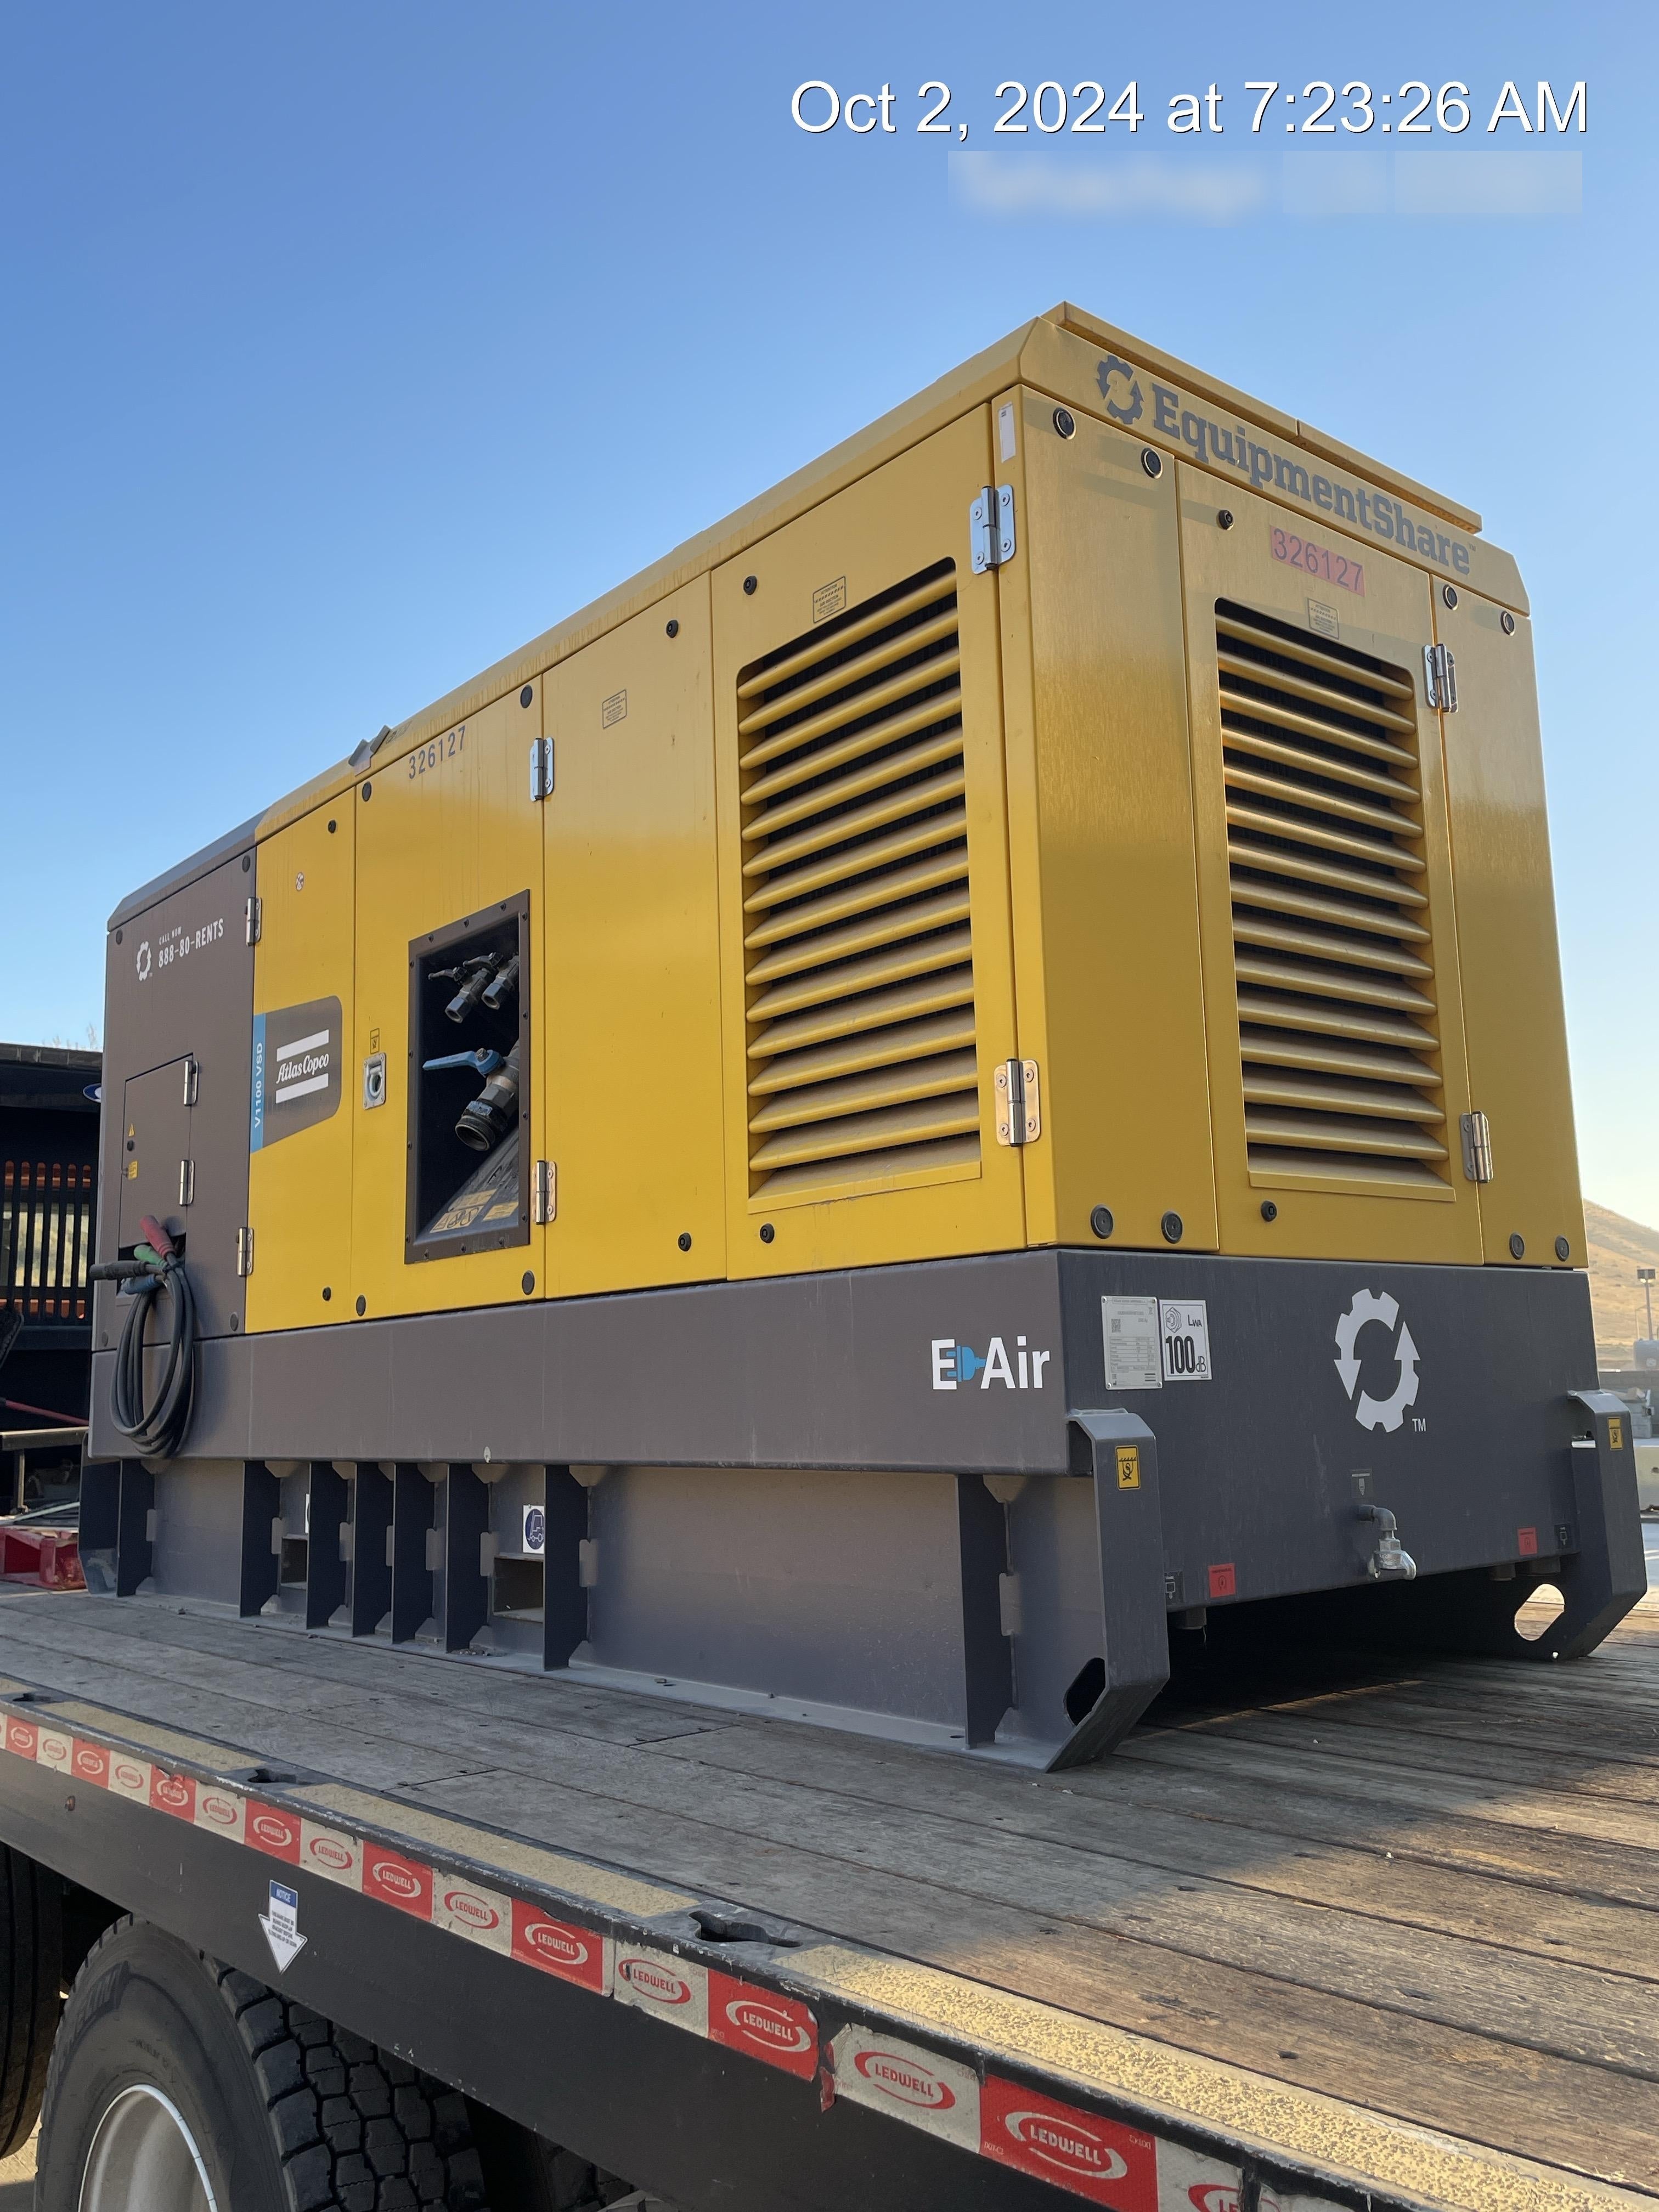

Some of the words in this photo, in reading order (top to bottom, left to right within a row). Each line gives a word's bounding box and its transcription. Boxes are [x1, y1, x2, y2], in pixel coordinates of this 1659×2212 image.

[1151, 381, 1471, 576] EquipmentShare
[1273, 527, 1364, 592] 326127
[408, 724, 466, 780] 326127
[158, 918, 224, 969] 888-80-RENTS
[159, 933, 170, 946] CALL
[171, 926, 183, 939] NOW
[275, 1060, 302, 1085] Atlas
[302, 1052, 329, 1076] Copco
[980, 1335, 1051, 1390] Air
[1165, 1335, 1196, 1374] 100
[1195, 1355, 1207, 1373] dB
[1412, 1417, 1427, 1433] TM
[209, 1804, 231, 1819] LEDWELL
[261, 1822, 284, 1839] LEDWELL
[318, 1844, 345, 1862] LEDWELL
[382, 1869, 411, 1891] LEDWELL
[454, 1898, 488, 1923] LEDWELL
[537, 1932, 575, 1956] LEDWELL
[633, 1968, 676, 1995] LEDWELL
[743, 2010, 794, 2042] LEDWELL
[874, 2062, 935, 2098] LEDWELL
[1029, 2124, 1102, 2166] LEDWELL
